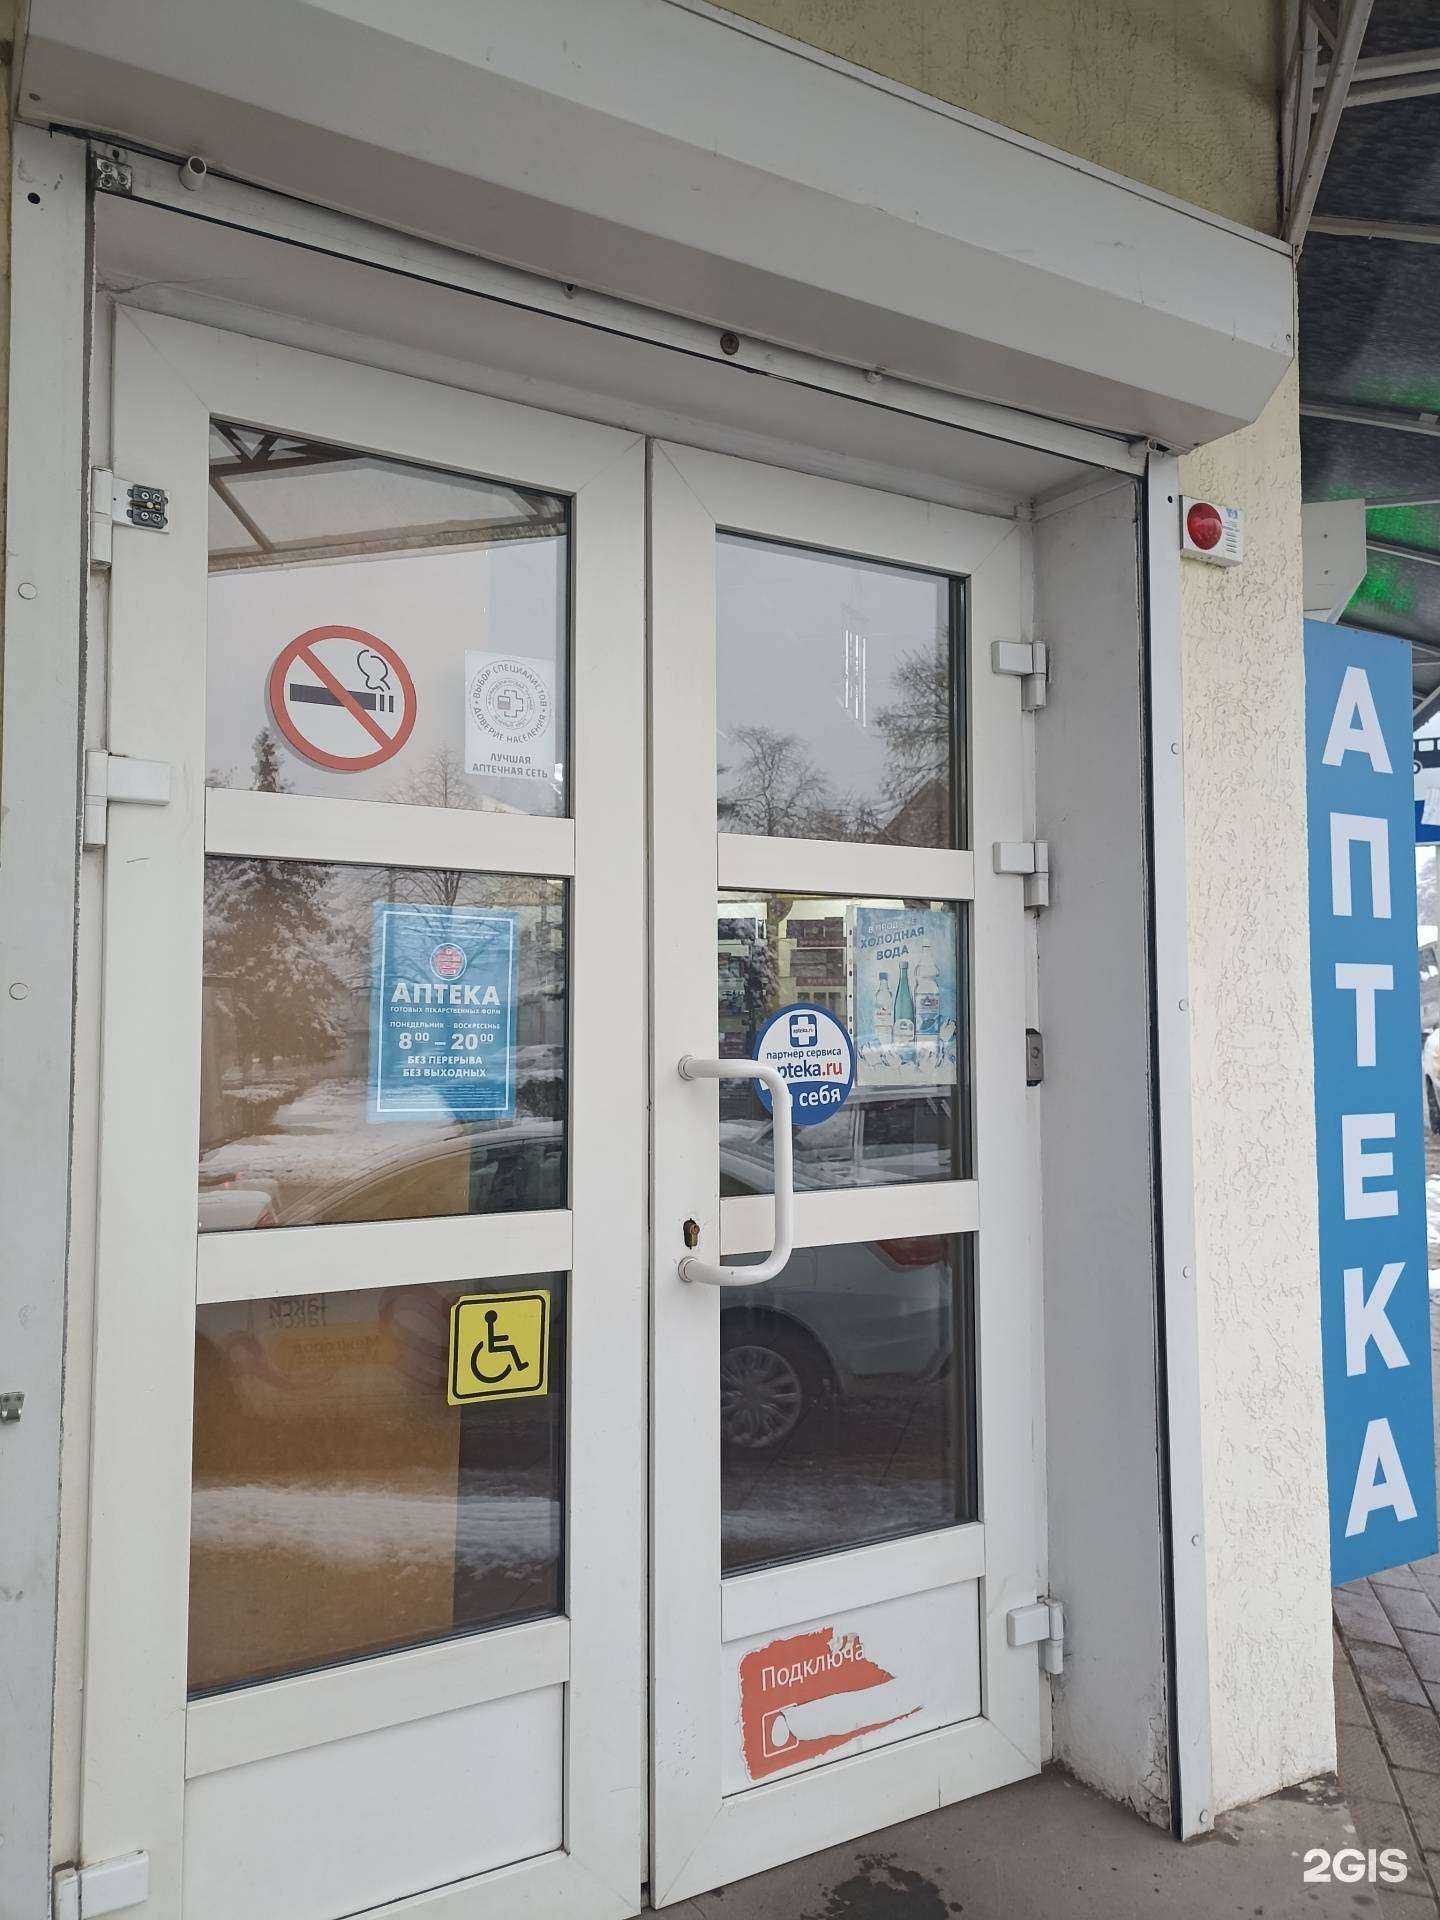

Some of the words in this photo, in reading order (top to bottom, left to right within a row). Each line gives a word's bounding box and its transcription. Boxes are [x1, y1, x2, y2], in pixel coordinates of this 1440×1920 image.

[472, 670, 491, 699] ВЫБОР
[473, 706, 504, 742] ДОВЕРИЕ
[506, 713, 547, 744] НАСЕЛЕНИЯ
[490, 752, 531, 765] ЛУЧШАЯ
[472, 763, 523, 776] АПТЕЧНАЯ
[525, 767, 548, 778] СЕТЬ
[860, 926, 925, 949] ХОЛОДНАЯ
[876, 945, 909, 961] ВОДА
[391, 982, 501, 1006] АПТЕКА
[407, 1055, 426, 1065] БЕЗ
[428, 1056, 482, 1065] ПЕРЕРЫВА
[766, 1050, 804, 1061] партнер
[806, 1047, 842, 1059] сервиса
[402, 1068, 421, 1077] БЕЗ
[423, 1068, 487, 1078] ВЫХОДНЫХ
[777, 1060, 843, 1079] pteka.ru
[799, 1085, 841, 1107] себя
[1320, 666, 1418, 1538] АПТЕКА
